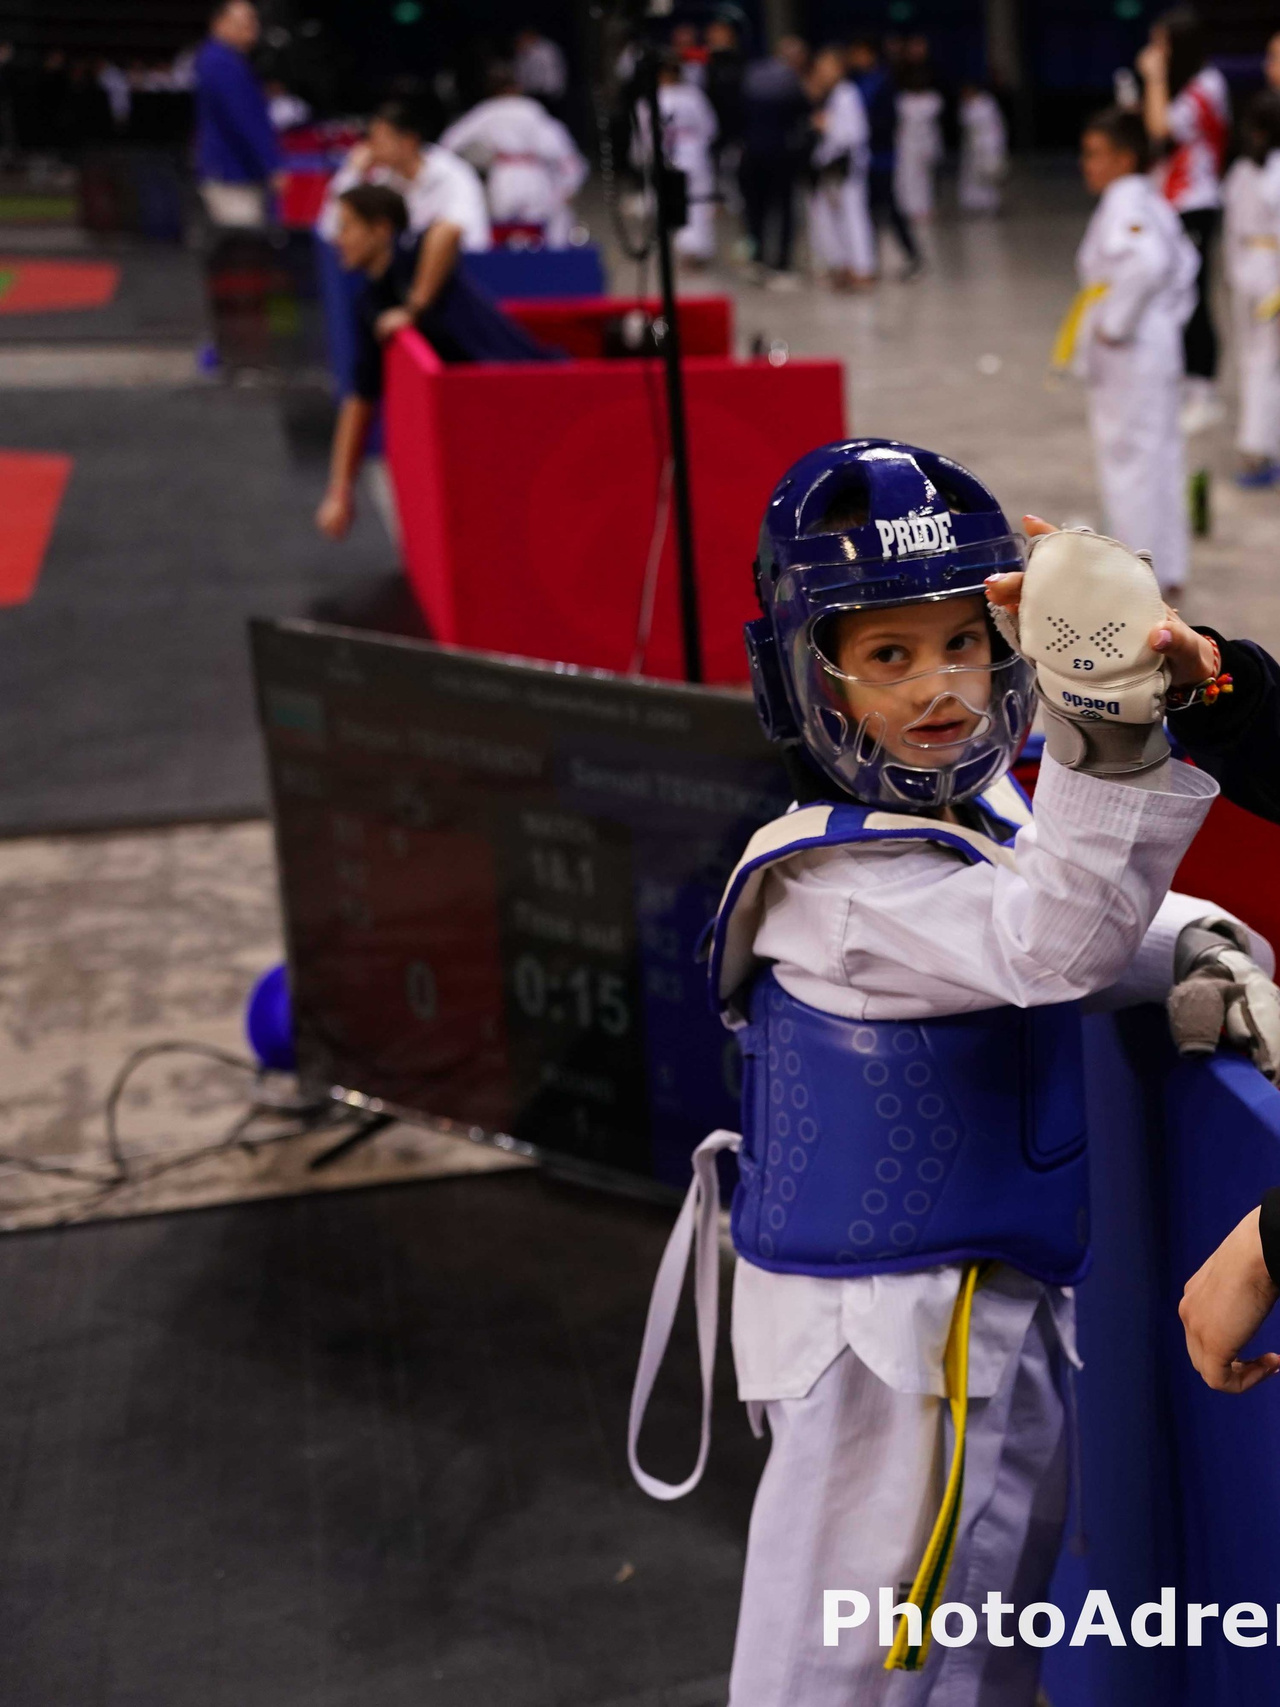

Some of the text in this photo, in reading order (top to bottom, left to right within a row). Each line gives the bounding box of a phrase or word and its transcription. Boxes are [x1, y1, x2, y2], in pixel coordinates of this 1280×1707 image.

[875, 511, 957, 558] PRIDE
[1073, 658, 1095, 671] G3
[1062, 691, 1120, 715] Daedo
[512, 953, 631, 1036] 0:15
